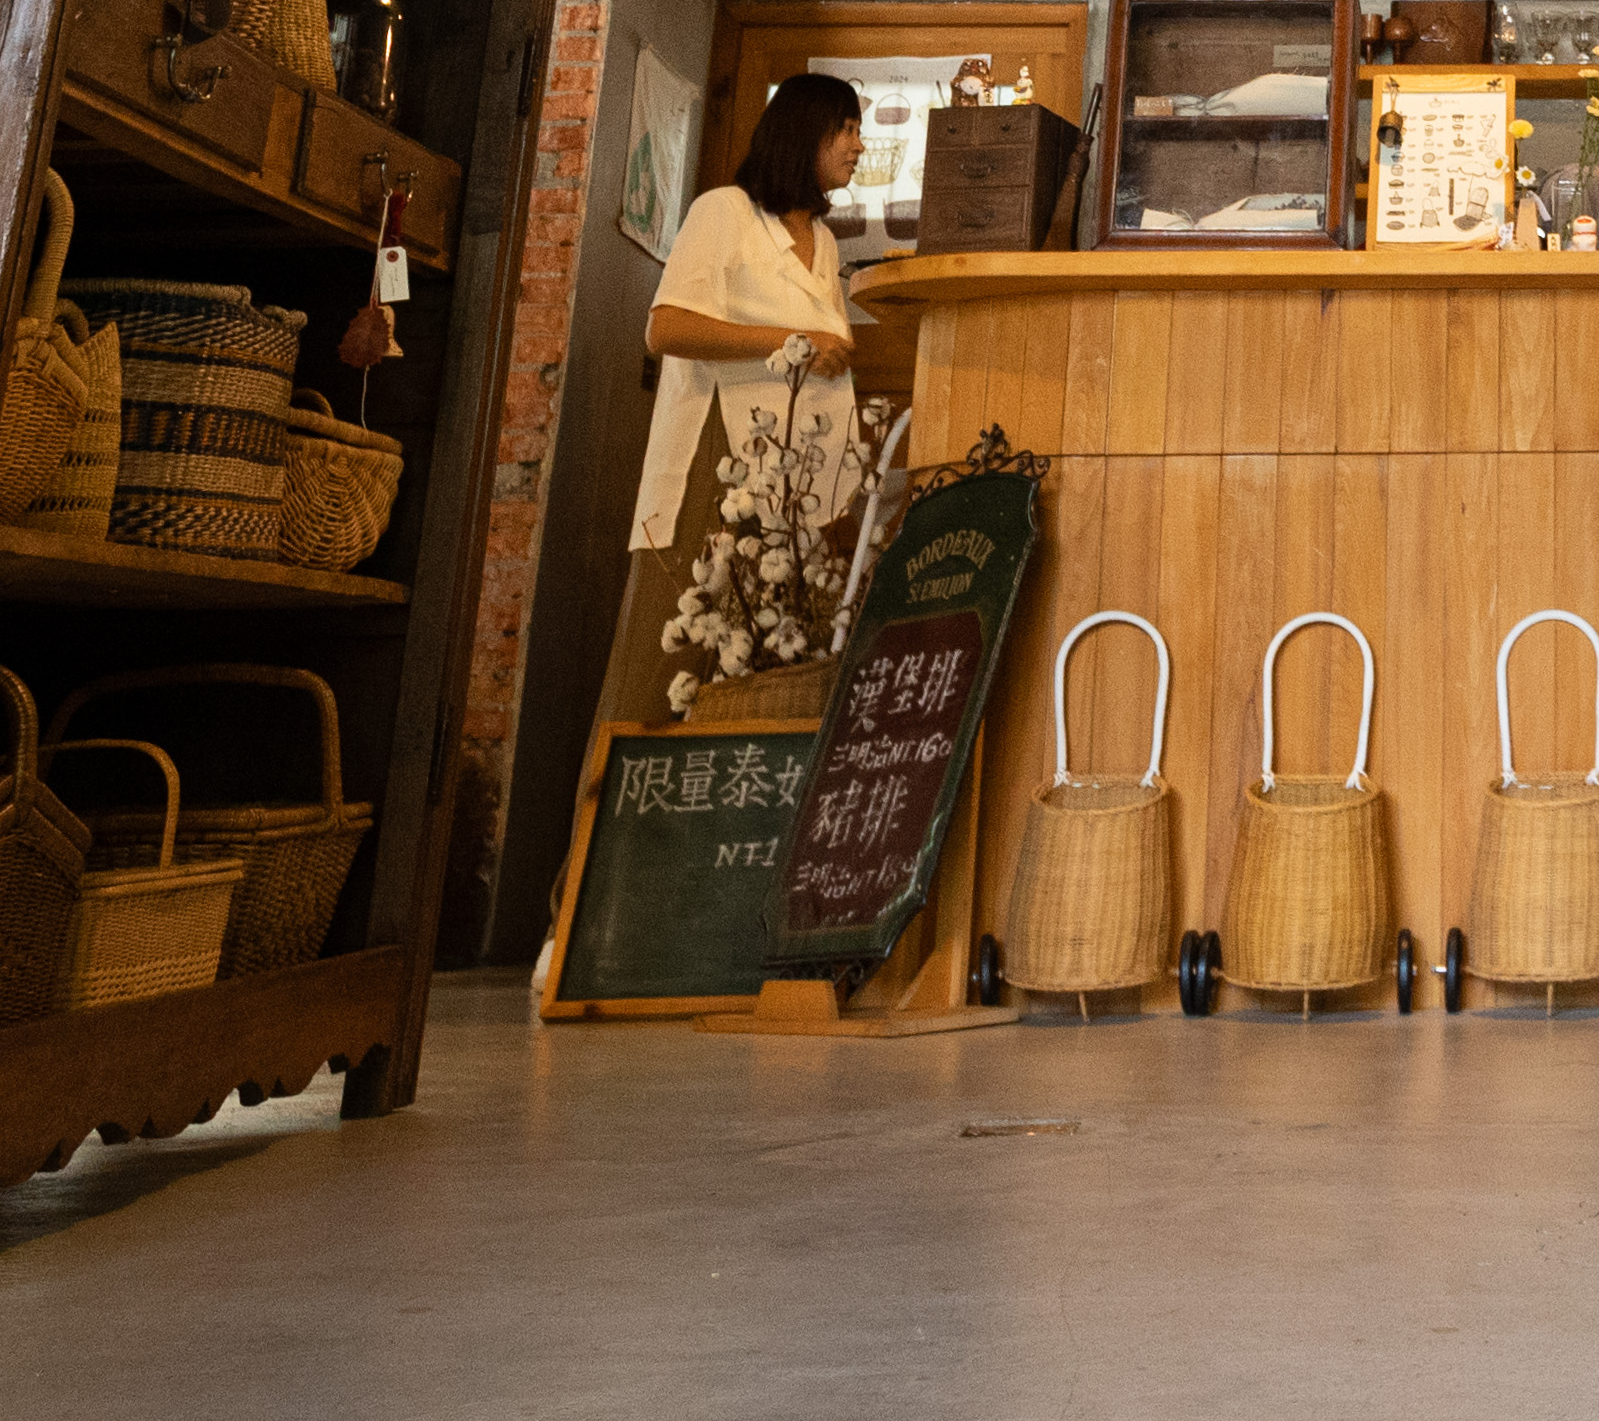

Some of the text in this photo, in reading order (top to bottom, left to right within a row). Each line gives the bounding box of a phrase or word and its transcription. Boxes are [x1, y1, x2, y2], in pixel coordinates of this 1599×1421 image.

[905, 529, 996, 582] BORDEAUX
[848, 648, 964, 734] 漢堡排
[808, 773, 909, 858] 豬排
